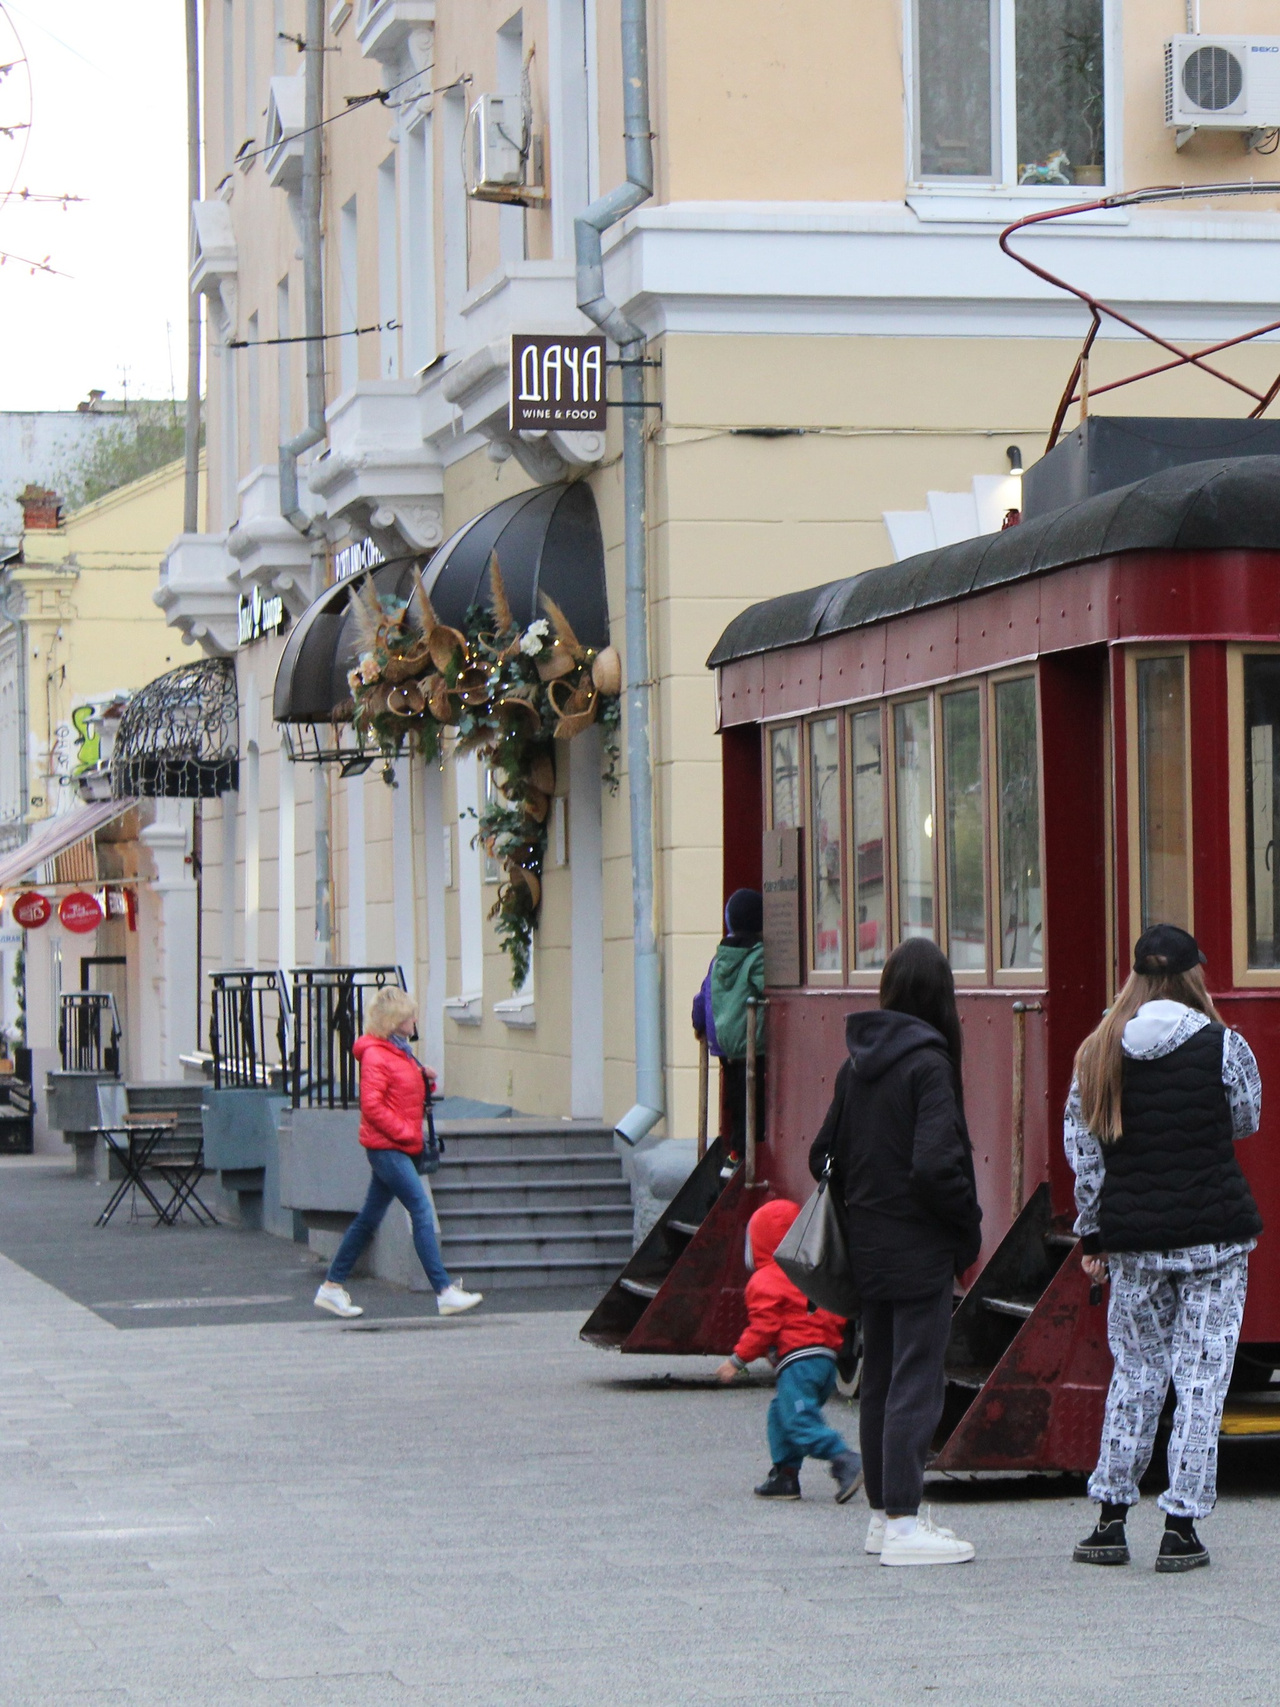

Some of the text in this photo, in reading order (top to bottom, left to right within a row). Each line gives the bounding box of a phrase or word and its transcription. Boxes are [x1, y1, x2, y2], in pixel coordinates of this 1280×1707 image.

[518, 344, 601, 402] ДАЧА
[522, 409, 597, 420] WINE & FOOD
